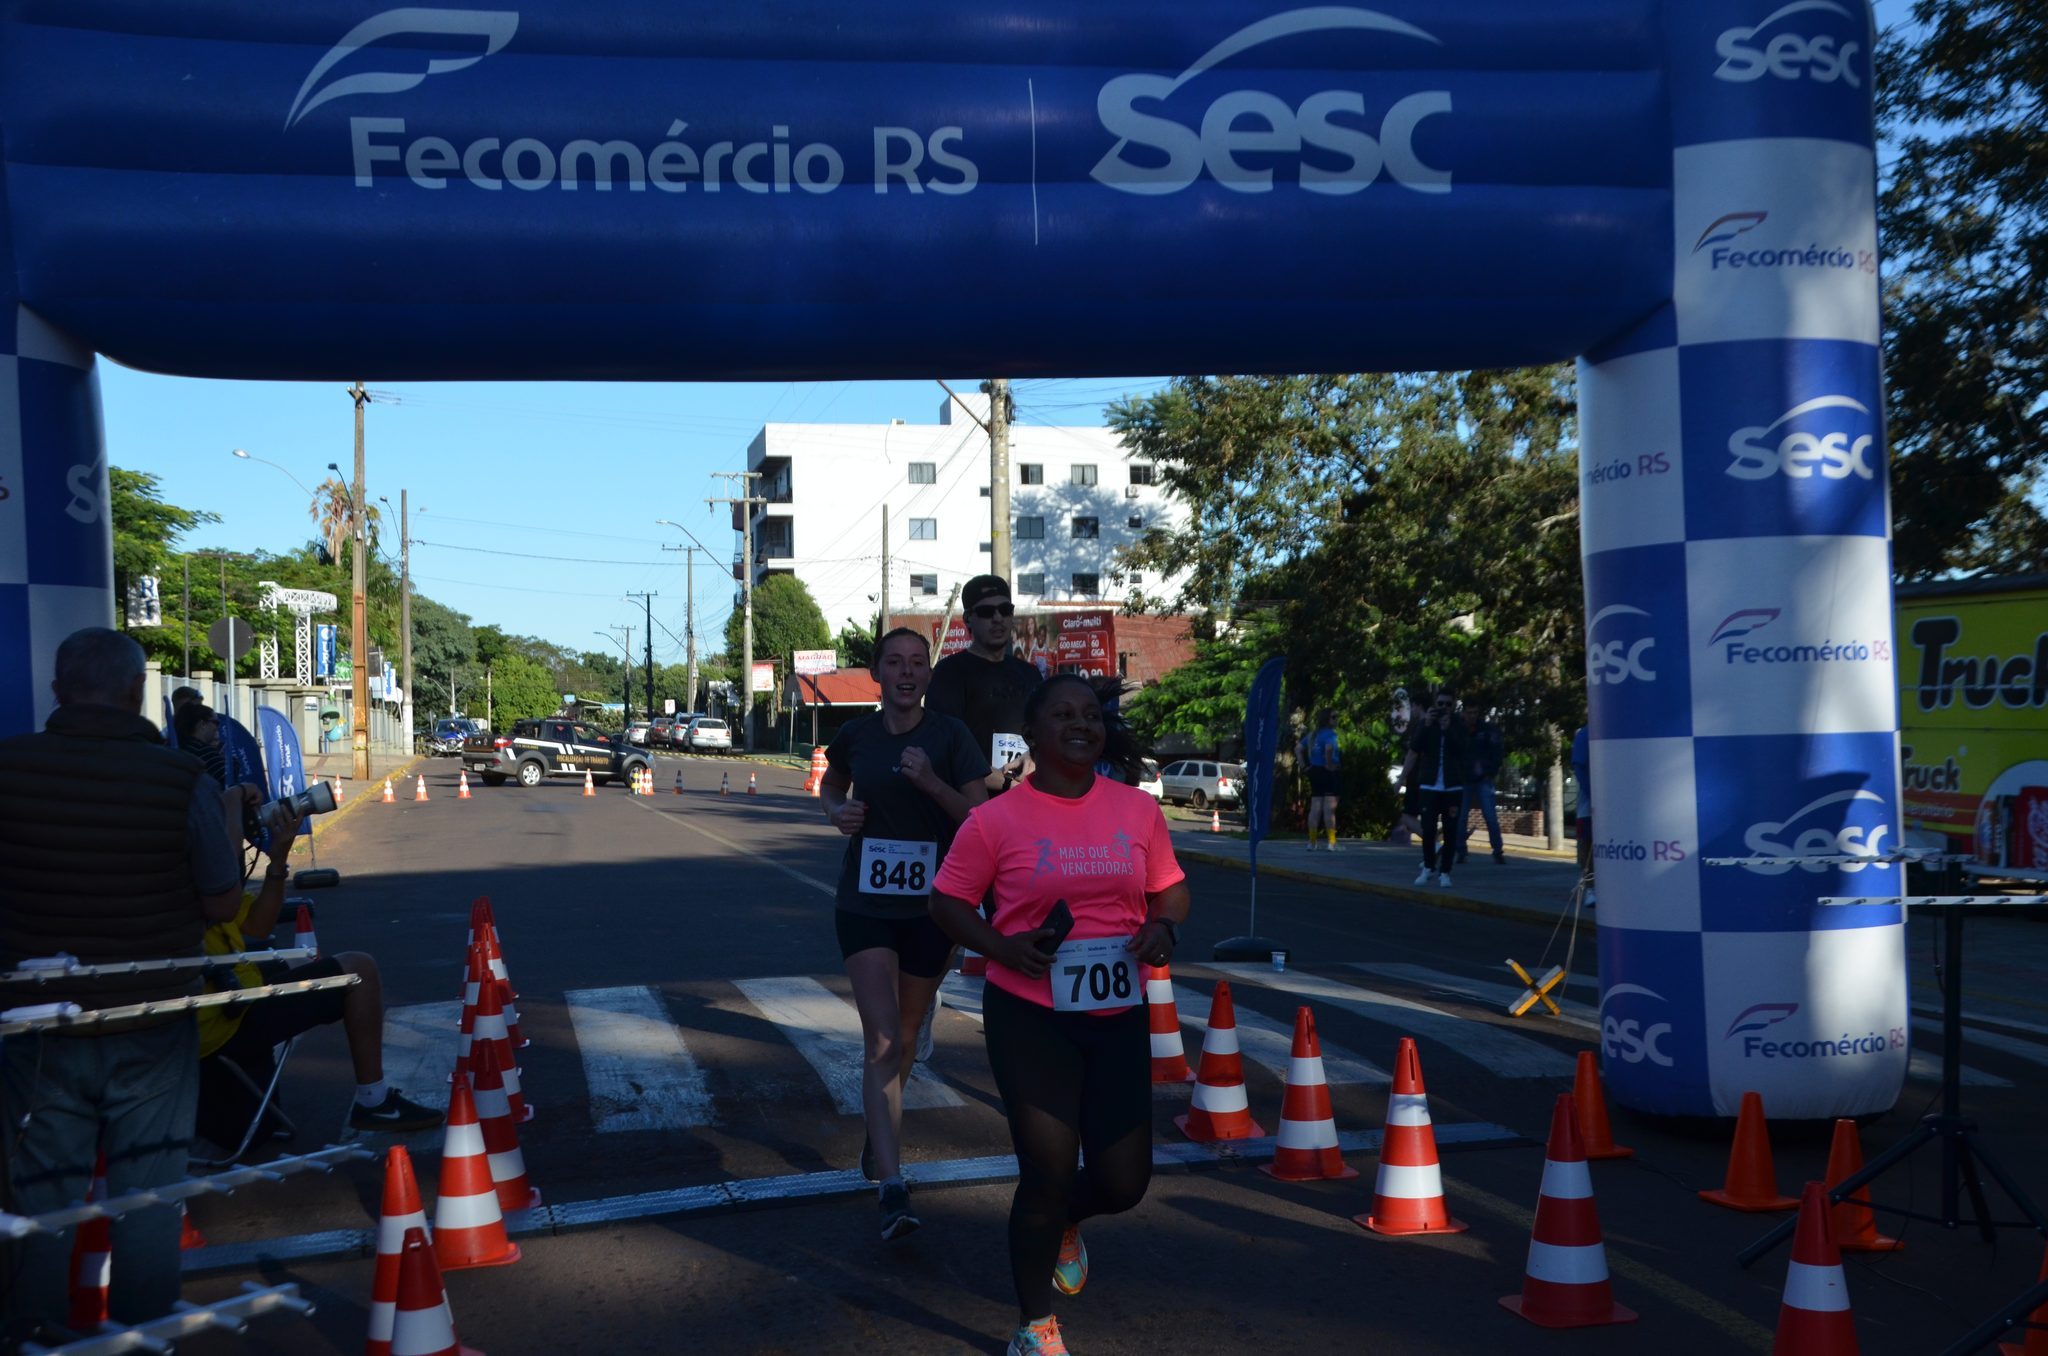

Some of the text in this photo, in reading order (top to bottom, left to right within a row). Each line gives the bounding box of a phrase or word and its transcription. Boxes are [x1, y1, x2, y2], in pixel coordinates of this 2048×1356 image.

[1713, 27, 1860, 89] Sesc
[1089, 73, 1453, 196] Sesc
[350, 117, 979, 196] Fecomércio RS
[1712, 243, 1853, 270] Fecomércio
[1638, 452, 1670, 477] RS
[1724, 426, 1874, 481] Sesc
[1588, 636, 1657, 685] esc
[1726, 640, 1868, 664] Fecomércio
[1059, 846, 1110, 859] MAIS QUE
[1594, 839, 1686, 862] mércio RS
[1742, 821, 1890, 875] Sesc
[870, 859, 926, 891] 848
[1064, 961, 1131, 1003] 708
[1604, 1015, 1675, 1067] esc
[1744, 1027, 1905, 1058] Fecomércio RS
